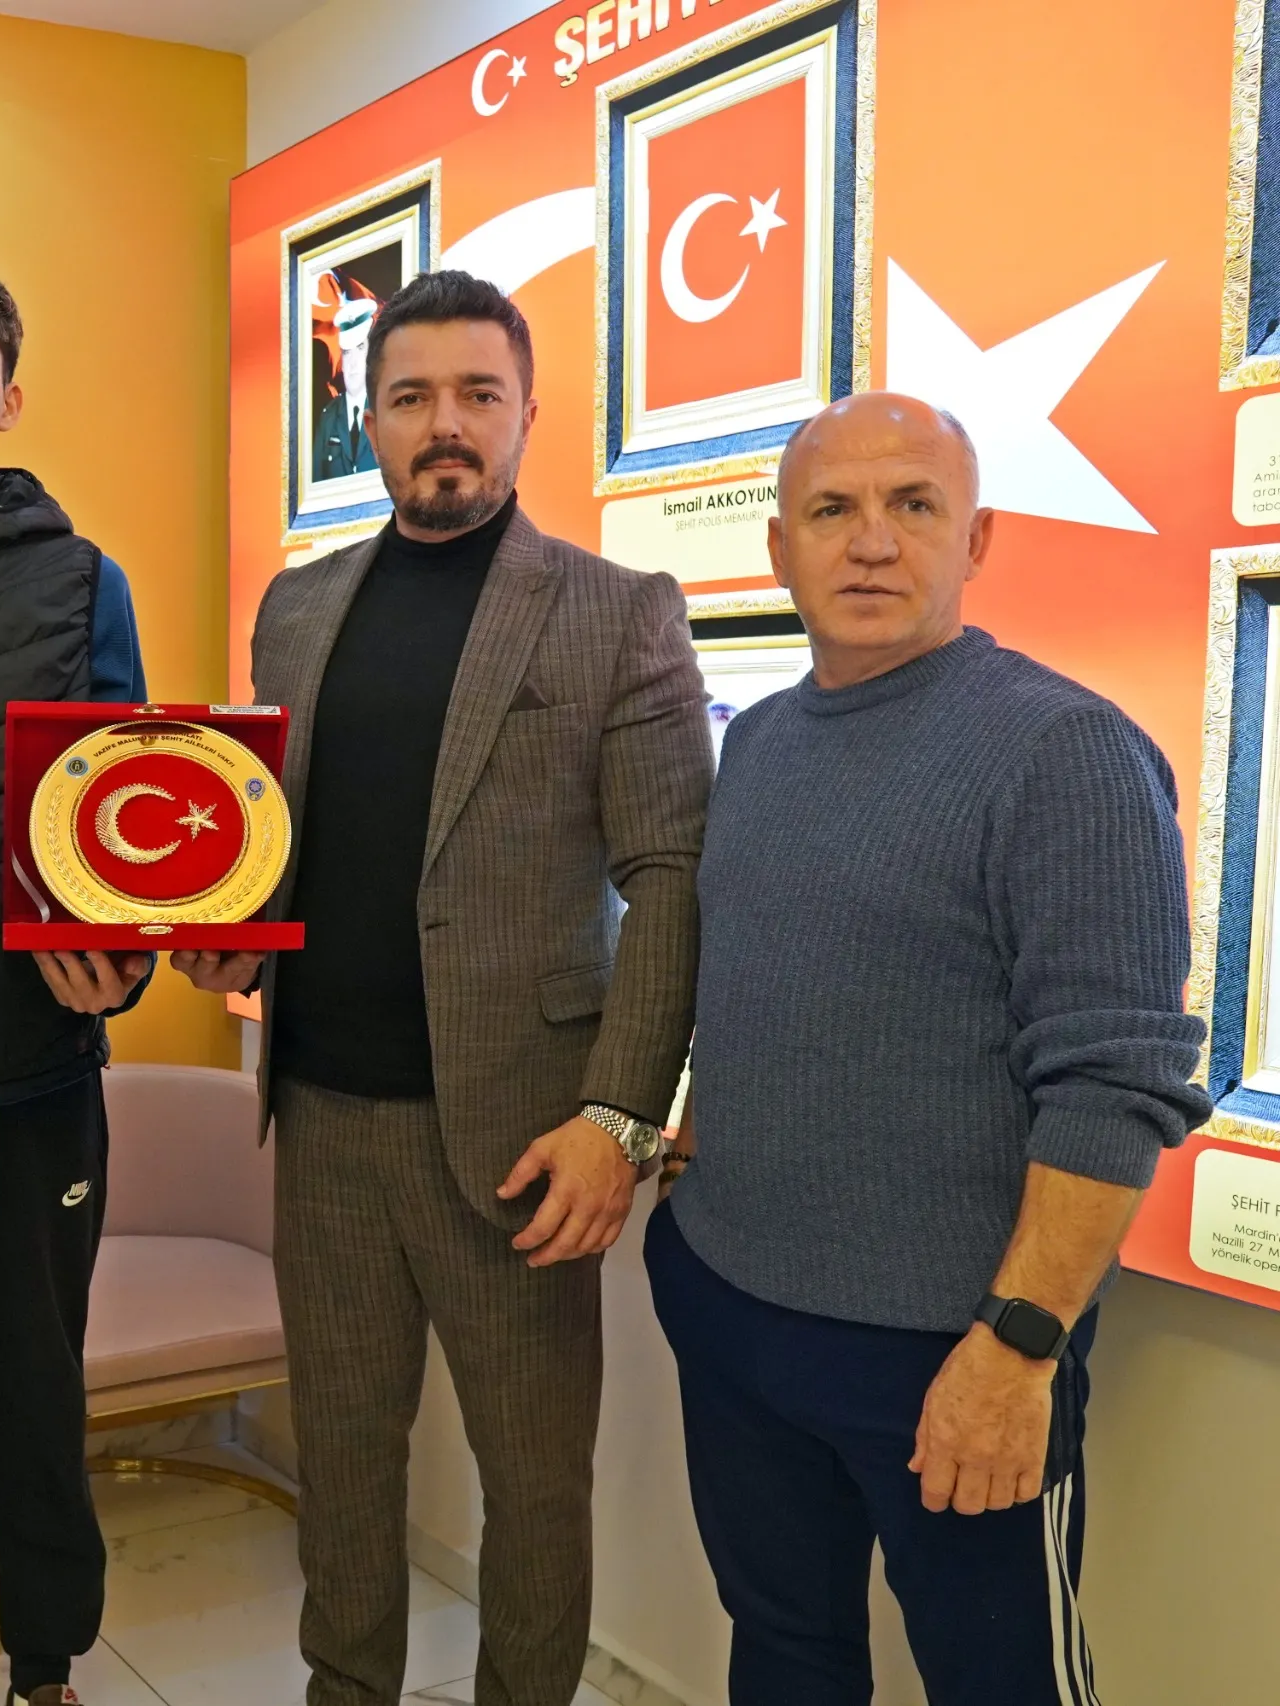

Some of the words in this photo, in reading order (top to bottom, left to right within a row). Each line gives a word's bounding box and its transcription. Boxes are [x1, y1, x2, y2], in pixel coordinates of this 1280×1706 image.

[663, 496, 702, 516] İsmail
[724, 510, 764, 524] MEMURU
[93, 743, 117, 757] VAZİFE
[184, 737, 218, 754] AİLELERİ
[217, 751, 236, 768] VAKFI
[1231, 1194, 1270, 1214] ŞEHİT
[1212, 1232, 1244, 1249] Nazilli
[1249, 1241, 1263, 1253] 27
[1234, 1224, 1280, 1242] Mardin'
[1211, 1247, 1252, 1265] yönelik
